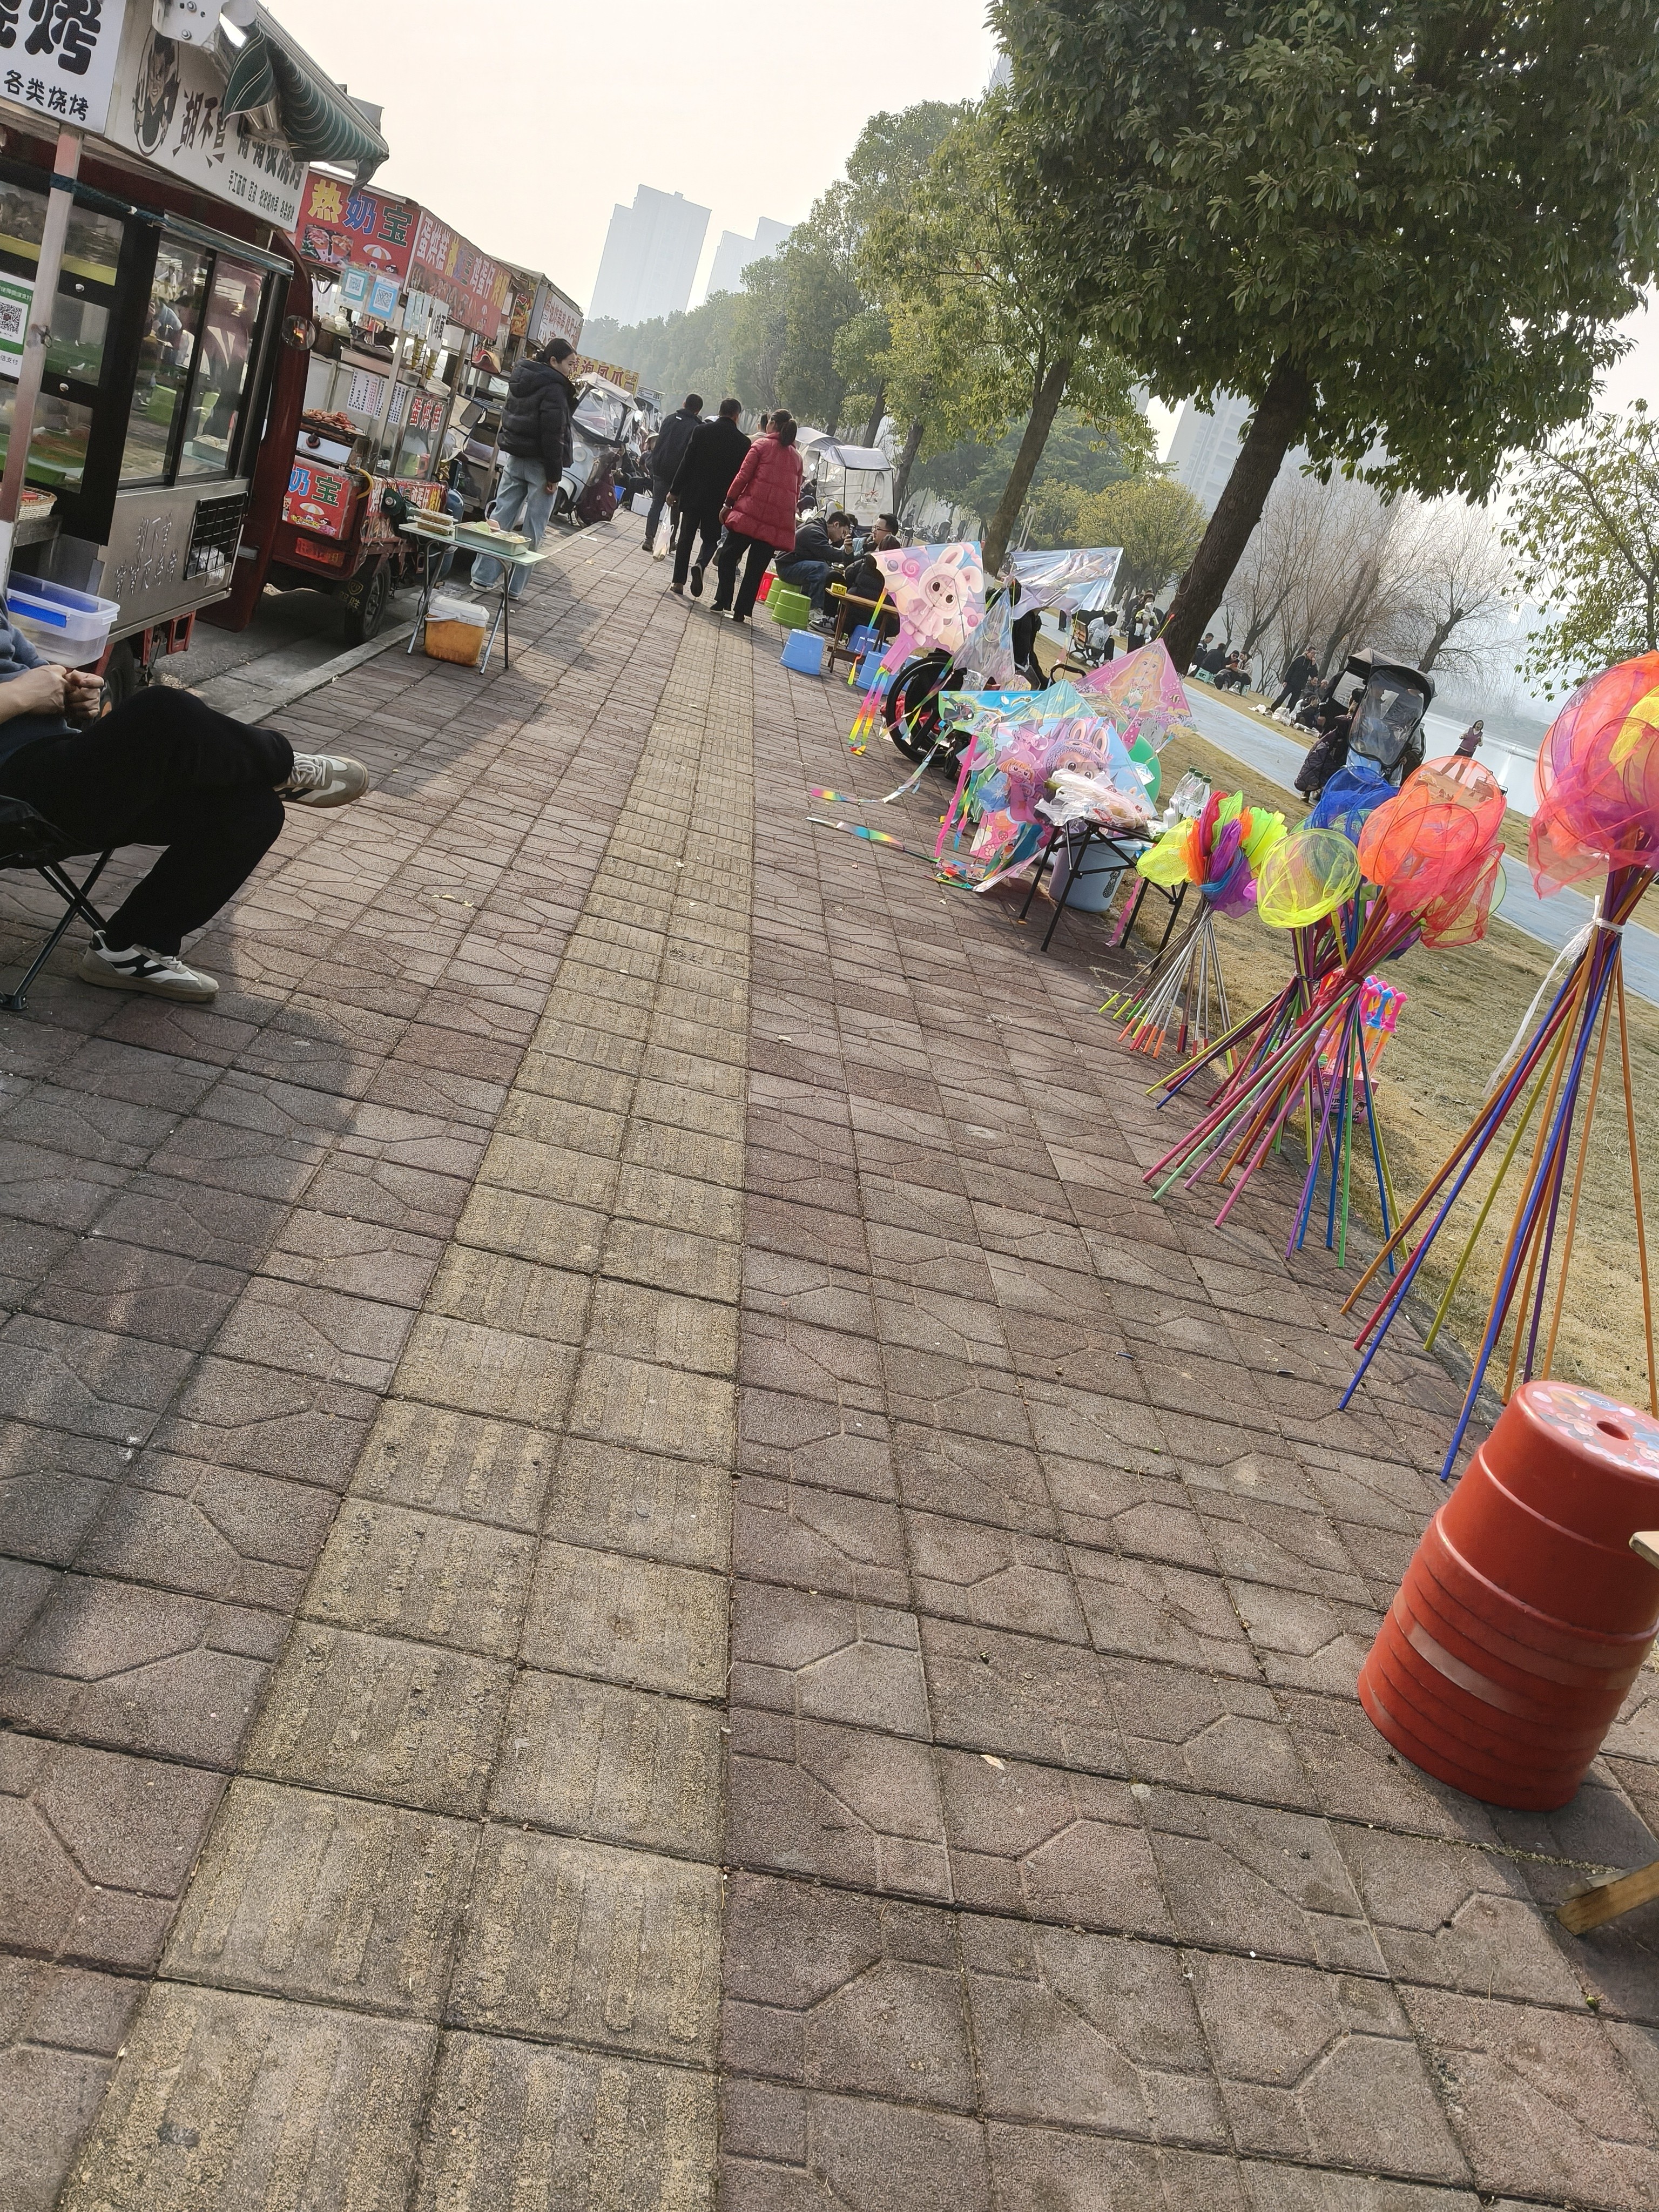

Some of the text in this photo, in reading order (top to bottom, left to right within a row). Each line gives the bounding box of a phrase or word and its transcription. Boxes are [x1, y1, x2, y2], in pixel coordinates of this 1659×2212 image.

[4, 70, 89, 121] 各类烧烤
[308, 179, 413, 247] 热奶宝
[288, 466, 342, 508] 奶宝
